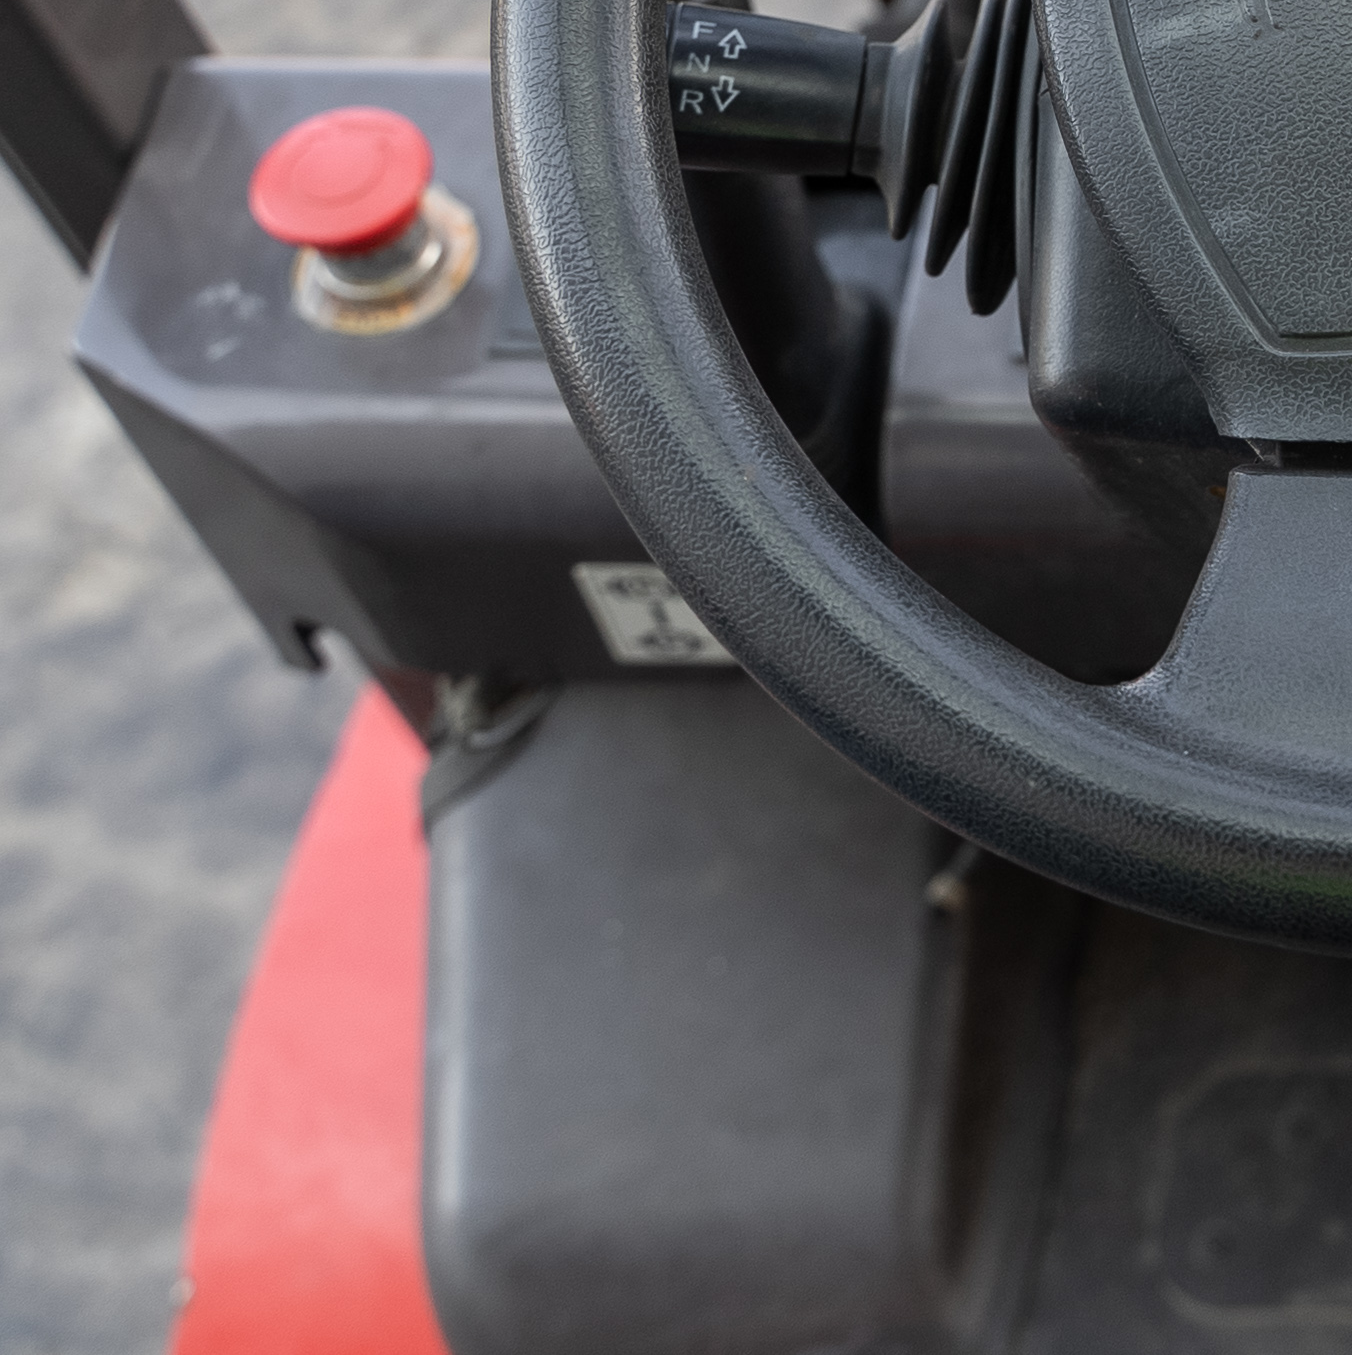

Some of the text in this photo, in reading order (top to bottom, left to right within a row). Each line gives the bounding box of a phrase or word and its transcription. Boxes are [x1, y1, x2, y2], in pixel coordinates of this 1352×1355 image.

[692, 20, 717, 39] F
[685, 52, 711, 73] N
[679, 89, 704, 115] R
